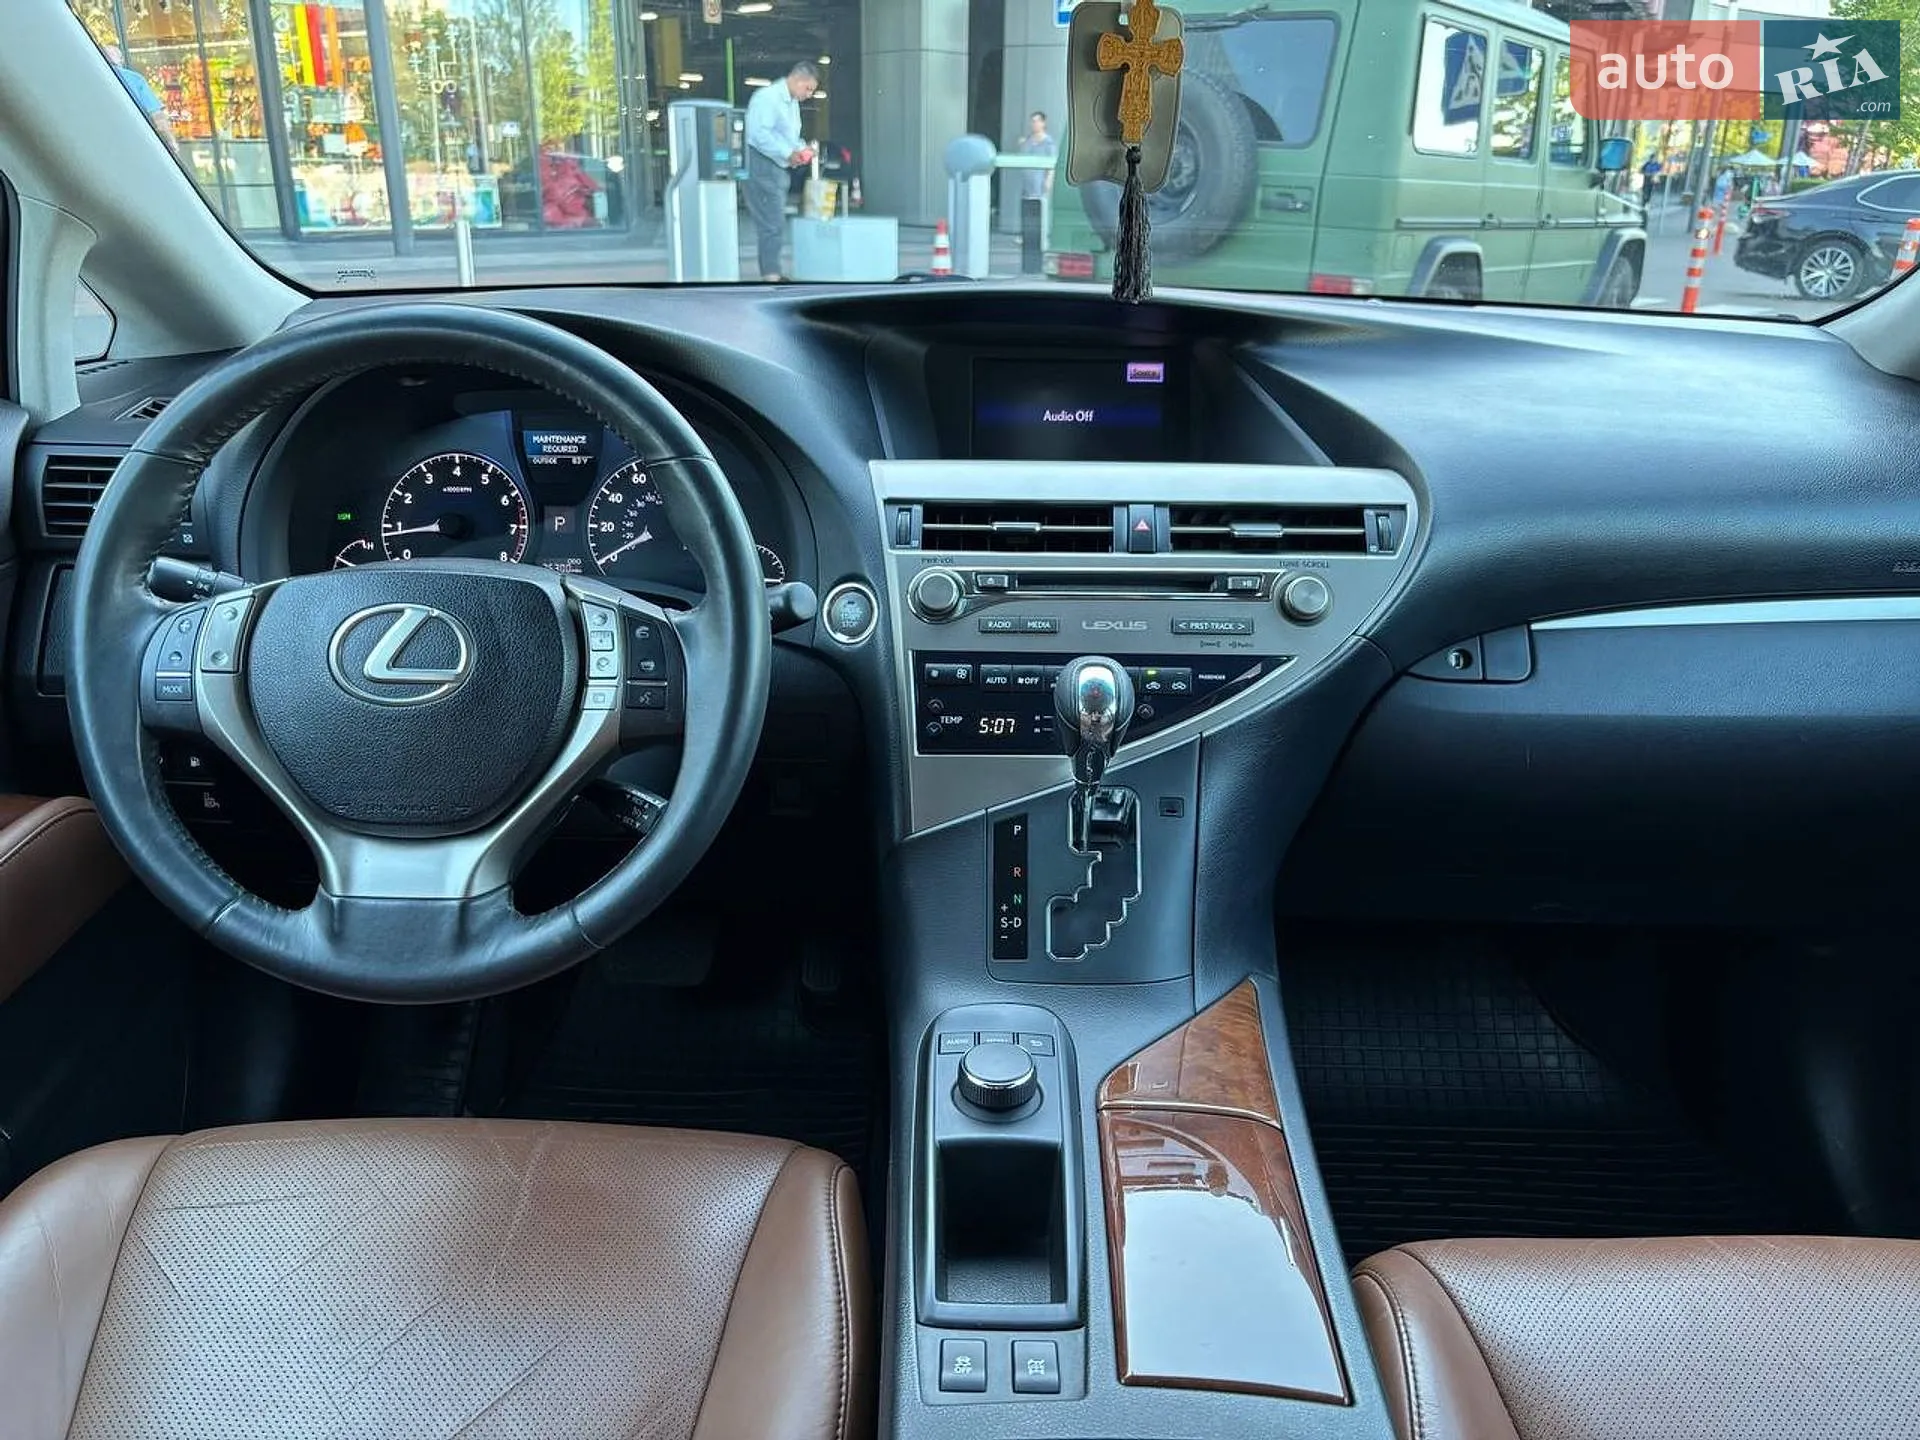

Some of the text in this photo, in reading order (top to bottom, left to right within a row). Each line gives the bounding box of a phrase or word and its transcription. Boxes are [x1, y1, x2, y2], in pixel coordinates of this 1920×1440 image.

[1043, 409, 1094, 422] Audio Off
[532, 434, 588, 445] MAINTENANCE
[542, 445, 579, 454] REQUIRED
[452, 466, 461, 478] 4
[424, 473, 434, 485] 3
[481, 473, 490, 485] 5
[632, 473, 647, 485] 60
[404, 493, 413, 504] 2
[500, 495, 510, 506] 6
[608, 492, 623, 504] 40
[510, 524, 518, 535] 7
[554, 515, 566, 532] P
[600, 521, 615, 533] 20
[403, 549, 412, 560] 0
[500, 551, 508, 562] 8
[988, 620, 1012, 629] RADIO
[1027, 620, 1051, 629] MEDIA
[1081, 619, 1148, 631] LEXUS
[985, 676, 1008, 685] AUTO
[1024, 676, 1040, 685] OFF
[940, 715, 963, 724] TEMP
[978, 717, 1016, 734] 5:07
[1013, 824, 1022, 836] P
[1013, 866, 1022, 878] R
[1013, 893, 1023, 905] N
